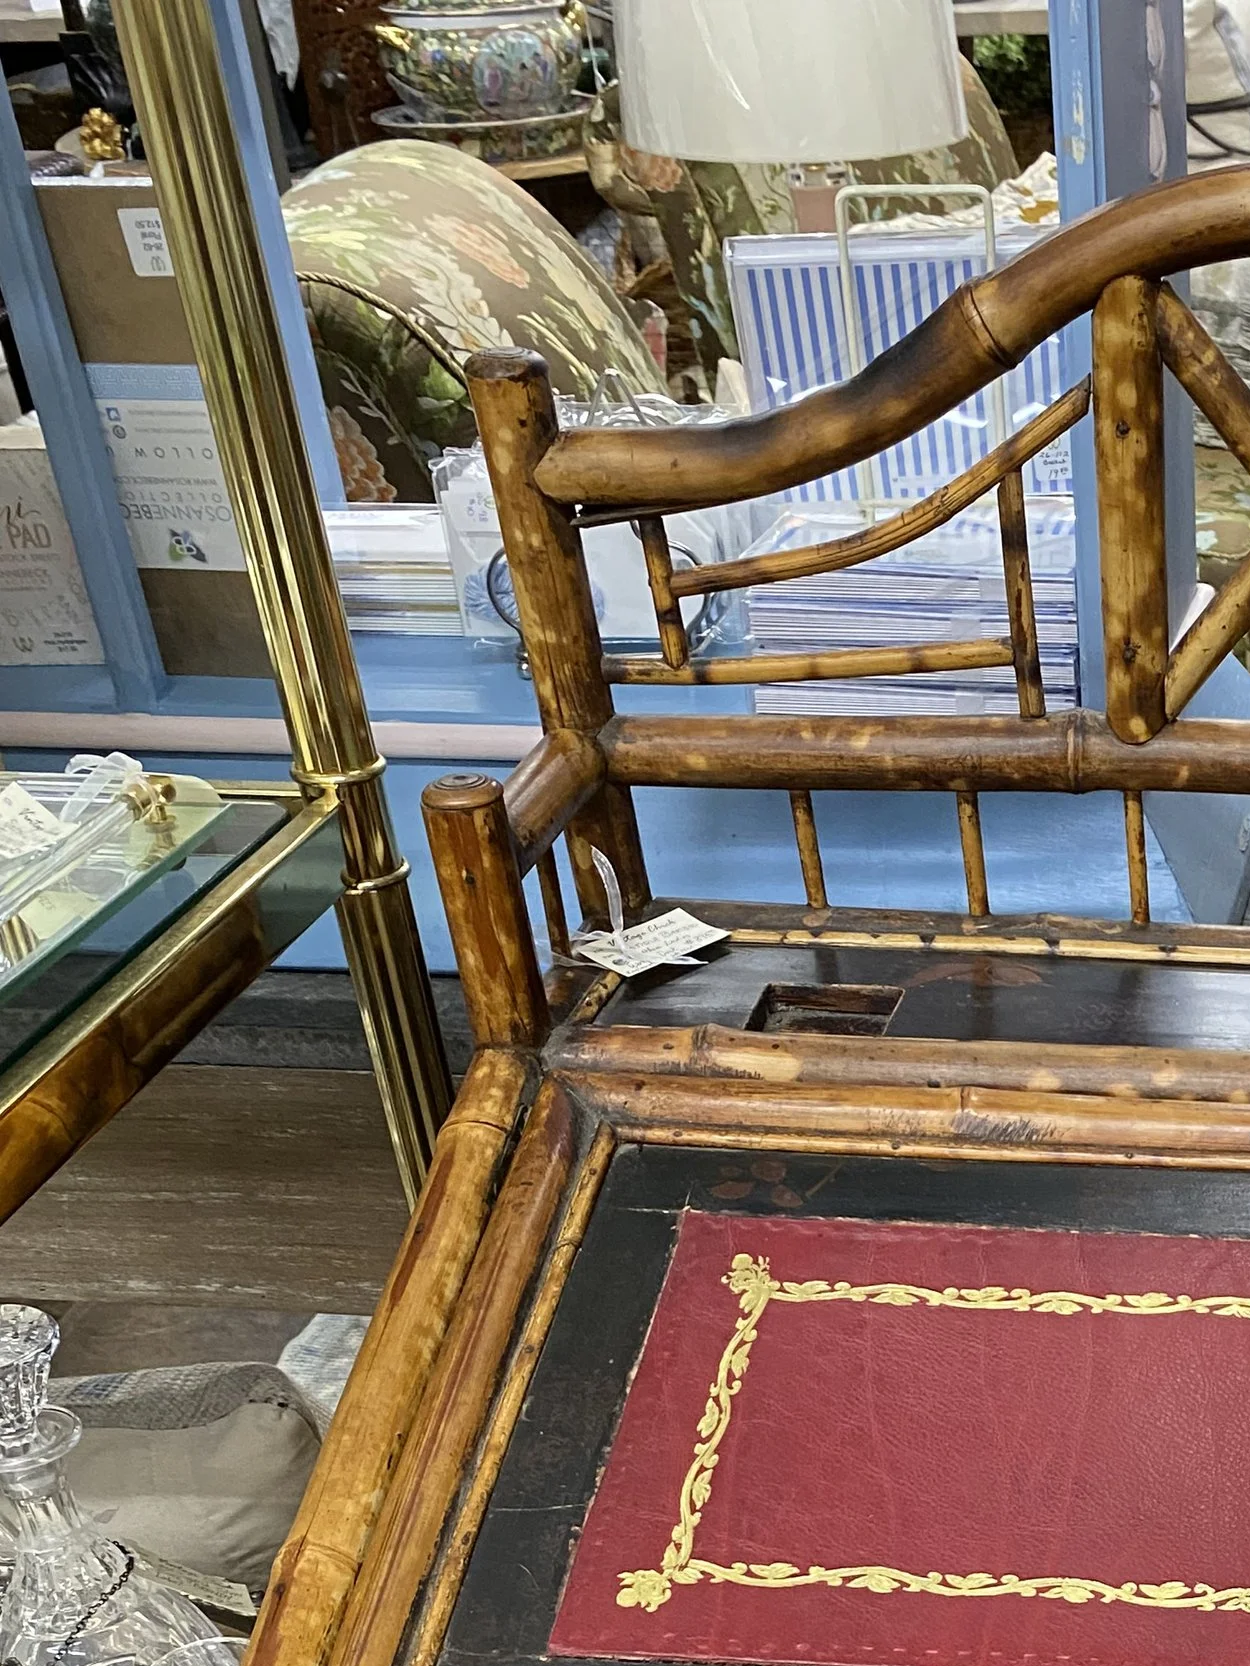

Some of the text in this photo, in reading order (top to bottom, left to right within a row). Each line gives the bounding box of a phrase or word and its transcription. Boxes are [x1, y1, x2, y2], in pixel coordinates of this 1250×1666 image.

[134, 446, 214, 460] OLLOW
[121, 490, 223, 503] OLLECTIO
[119, 502, 232, 522] OSANNEBEC
[6, 523, 52, 549] PAD
